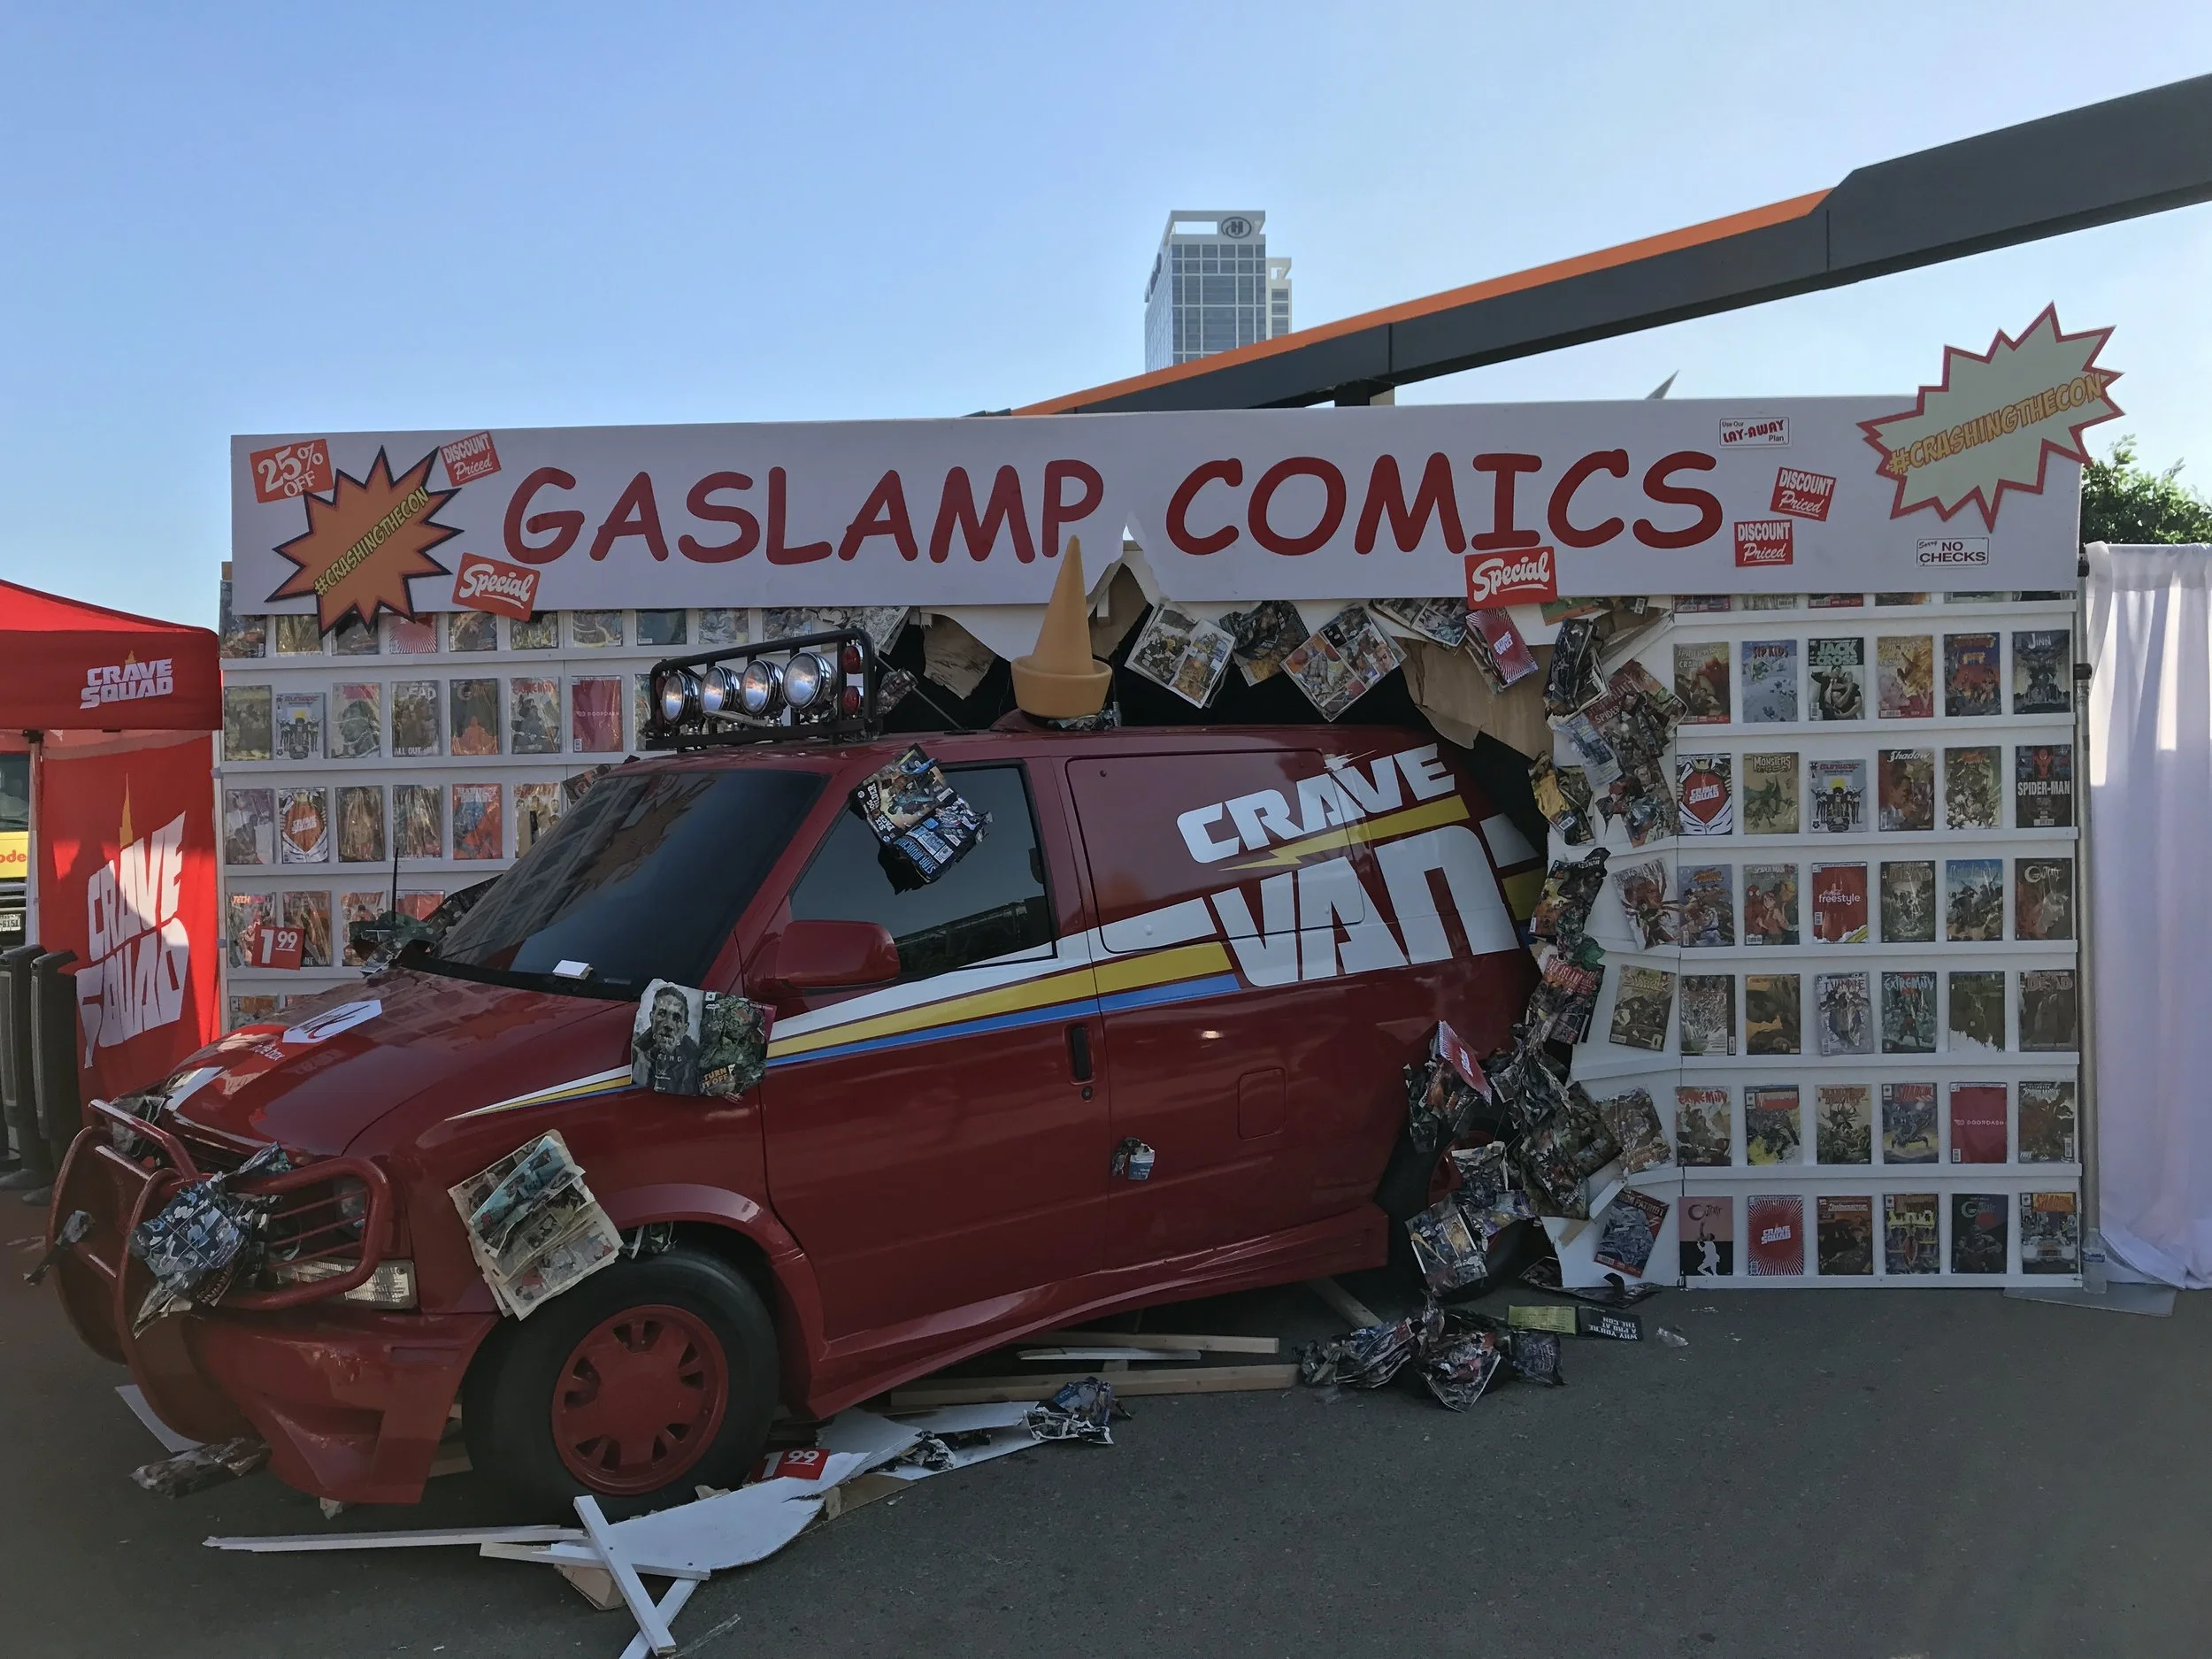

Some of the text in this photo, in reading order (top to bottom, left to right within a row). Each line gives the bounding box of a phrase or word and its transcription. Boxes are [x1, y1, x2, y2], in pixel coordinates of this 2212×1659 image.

[1723, 419, 1785, 443] LAY-AWAY
[1887, 372, 2103, 475] #CRASHINGTHECON
[443, 433, 492, 465] DISCOUNT
[1768, 434, 1785, 443] Plan
[257, 442, 325, 494] 25%
[452, 453, 494, 480] Priced
[283, 470, 316, 497] OFF
[1778, 469, 1835, 497] DISCOUNT
[503, 448, 1724, 566] GASLAMP COMICS
[1778, 489, 1823, 515] Priced
[314, 486, 431, 596] #CRASHINGTHECON
[1737, 522, 1791, 541] DISCOUNT
[1917, 540, 1938, 549] Sorry
[1743, 542, 1786, 562] Priced
[1918, 551, 1986, 564] CHECKS
[1941, 541, 1964, 552] NO
[458, 563, 535, 603] Special
[1471, 549, 1551, 603] Special
[1816, 655, 1859, 665] CROSS
[1818, 641, 1857, 655] JACK
[87, 657, 173, 687] CRAVE
[80, 675, 173, 710] SQUAD
[1754, 755, 1792, 770] MONSTERS
[2016, 780, 2070, 796] SPIDER-MAN
[1176, 742, 1455, 864] CRAVE
[87, 810, 187, 964] CRAVE
[1818, 893, 1861, 906] freestyle
[75, 917, 190, 1069] SQUAD
[703, 1067, 728, 1081] TURN
